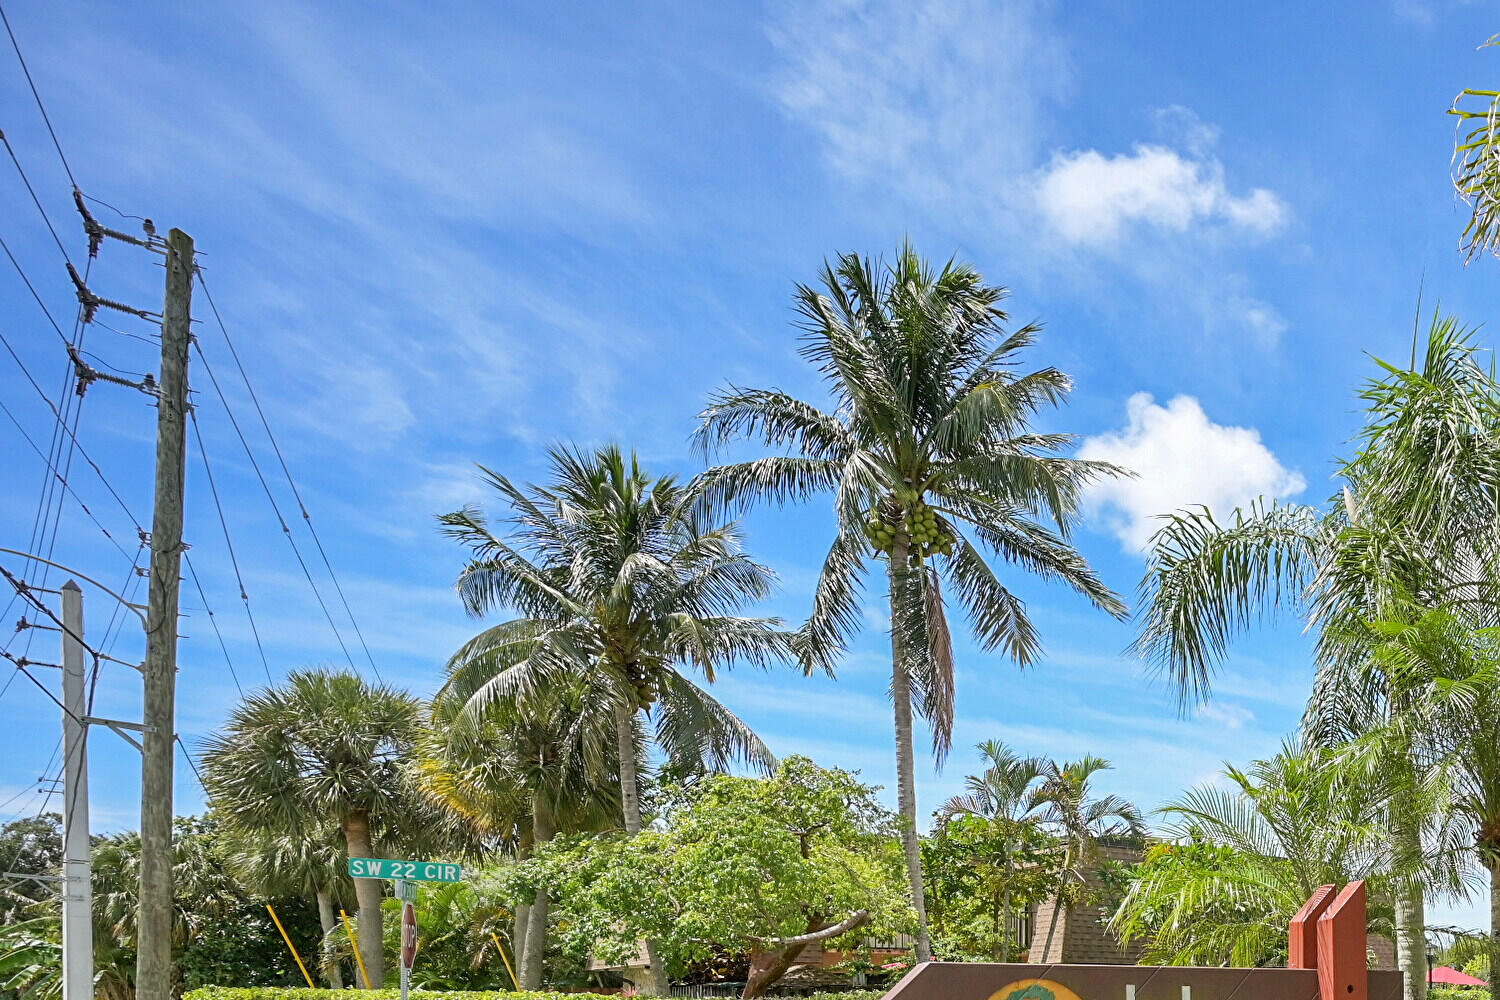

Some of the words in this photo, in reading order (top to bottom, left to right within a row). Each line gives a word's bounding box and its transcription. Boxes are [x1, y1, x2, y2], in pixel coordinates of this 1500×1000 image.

[351, 860, 382, 876] SW
[391, 862, 416, 878] 22
[424, 864, 456, 880] CIR
